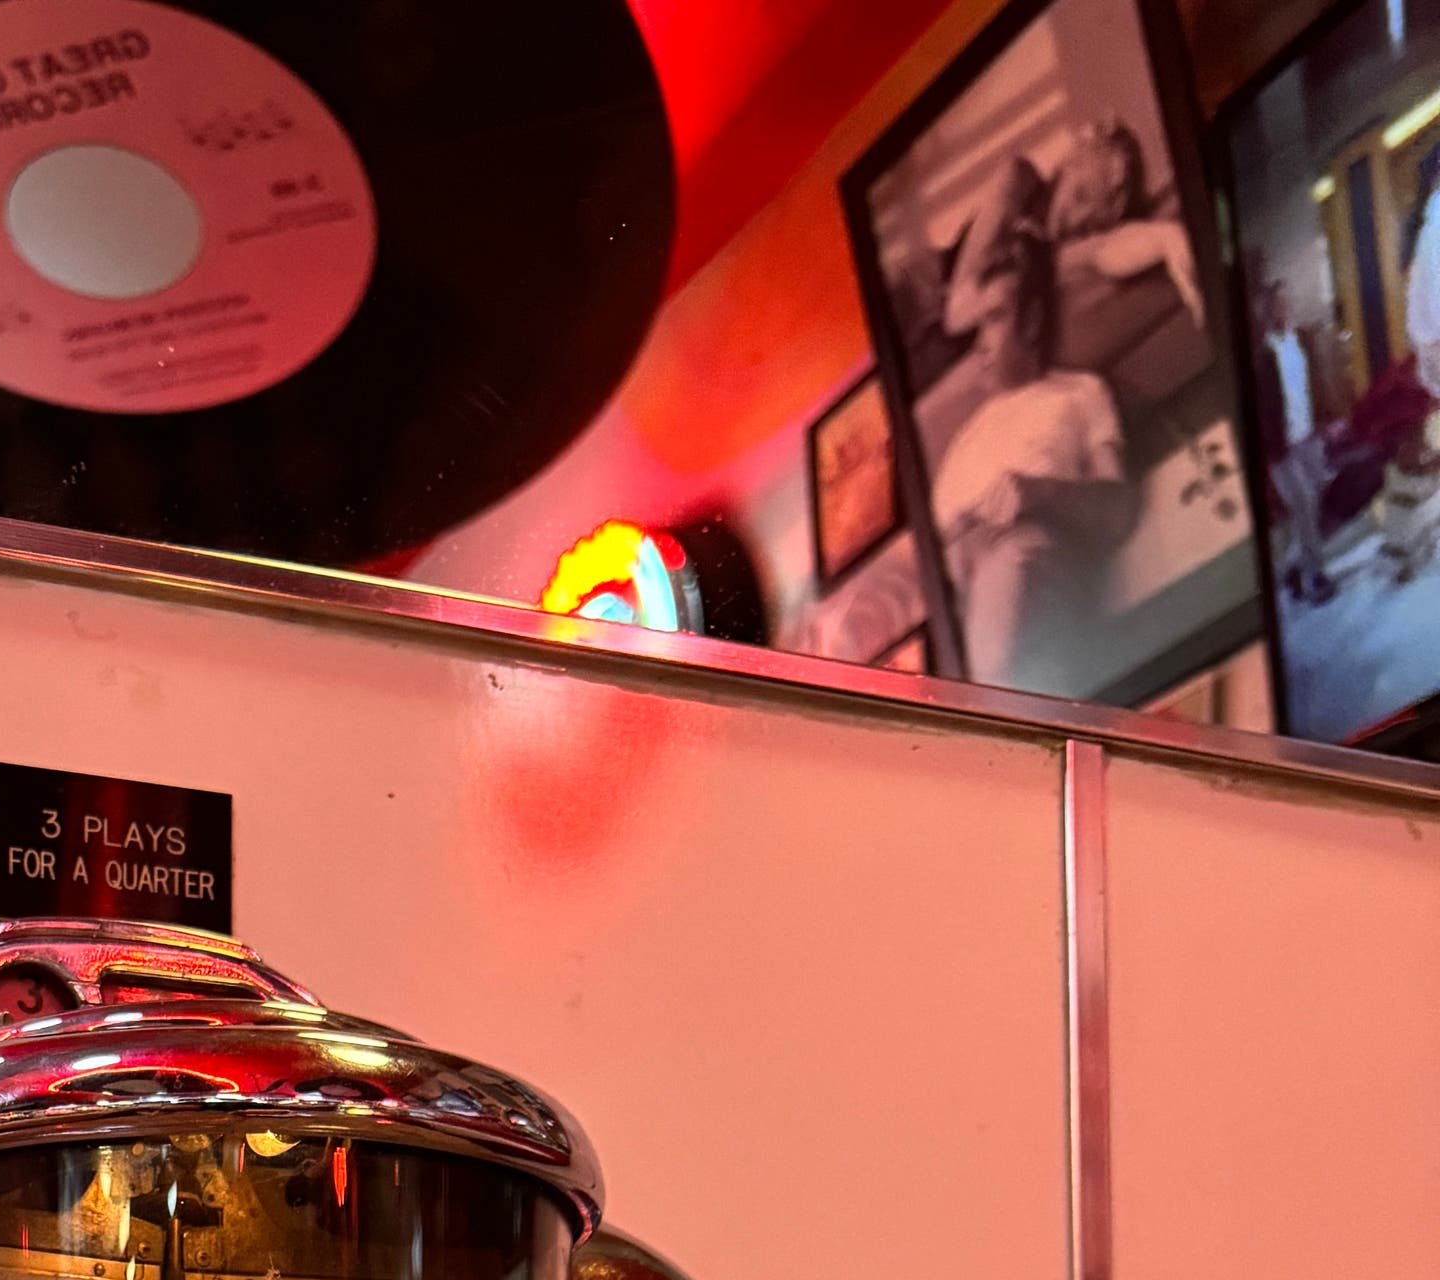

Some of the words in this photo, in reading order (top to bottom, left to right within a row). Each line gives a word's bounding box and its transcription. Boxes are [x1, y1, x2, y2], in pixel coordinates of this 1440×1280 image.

[41, 809, 61, 839] 3
[83, 815, 186, 856] PLAYS
[8, 847, 56, 881] FOR
[73, 856, 89, 885] A
[105, 860, 215, 901] QUARTER
